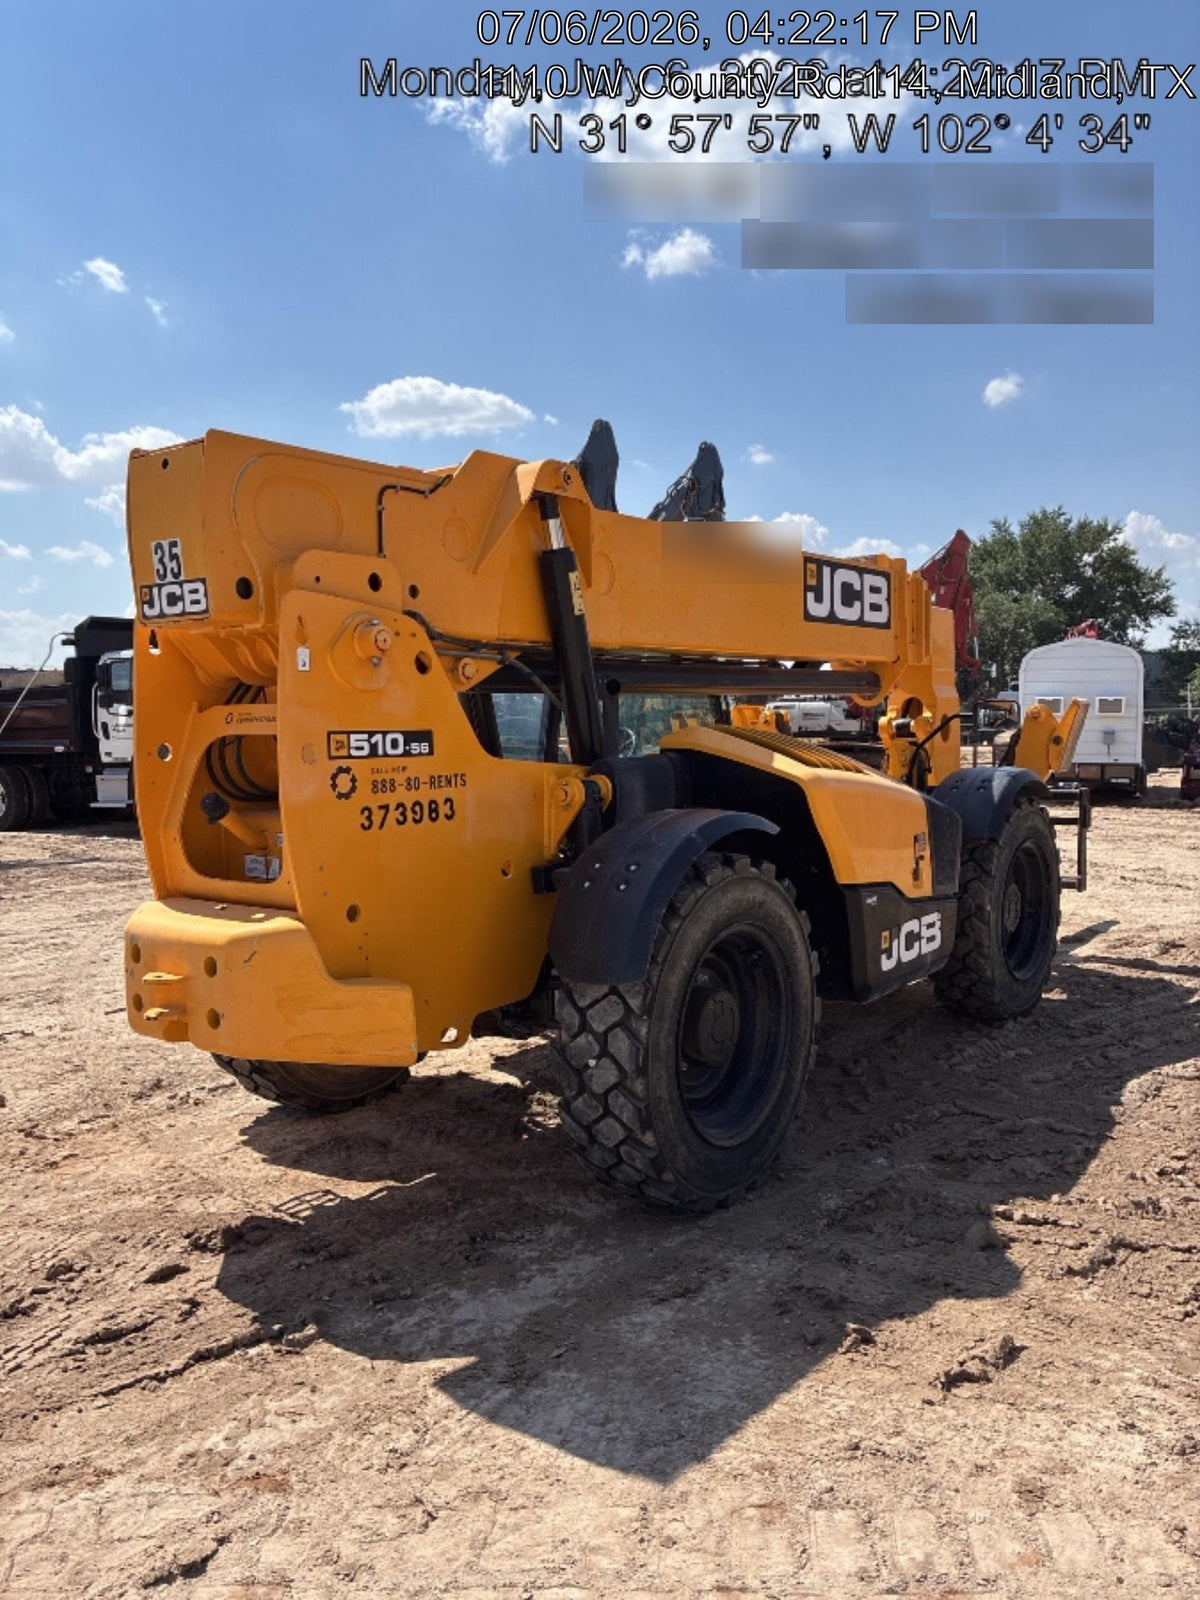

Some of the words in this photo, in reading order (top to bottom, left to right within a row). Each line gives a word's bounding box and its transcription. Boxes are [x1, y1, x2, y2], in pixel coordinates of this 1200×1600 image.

[154, 540, 181, 581] 35
[143, 581, 206, 617] JCB
[806, 564, 889, 623] JCB
[360, 797, 456, 831] 373983
[880, 911, 941, 972] JCB
